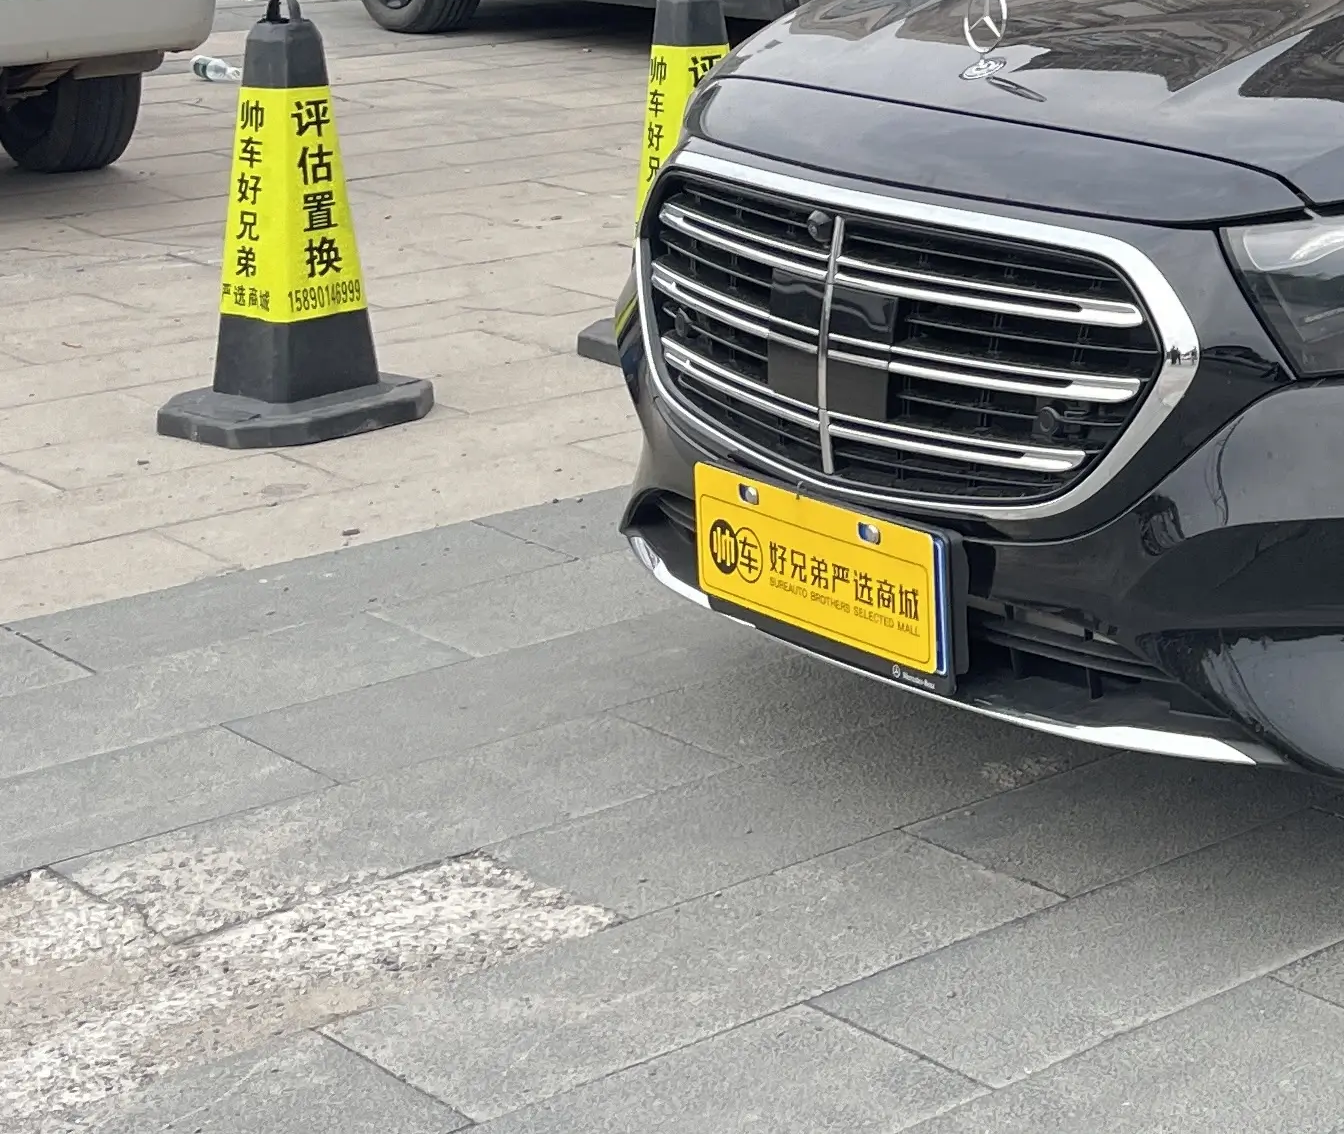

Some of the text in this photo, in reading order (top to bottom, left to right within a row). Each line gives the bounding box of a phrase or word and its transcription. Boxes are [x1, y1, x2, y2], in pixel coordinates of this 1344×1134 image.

[235, 99, 265, 278] 帅车好兄弟
[290, 98, 343, 279] 评估置换
[221, 282, 271, 313] 严选商城
[287, 278, 362, 313] 15890146999
[768, 540, 920, 622] 好兄弟严选商城
[810, 590, 851, 614] BROTHERS
[853, 606, 895, 629] SELECTED
[897, 620, 921, 638] MALL
